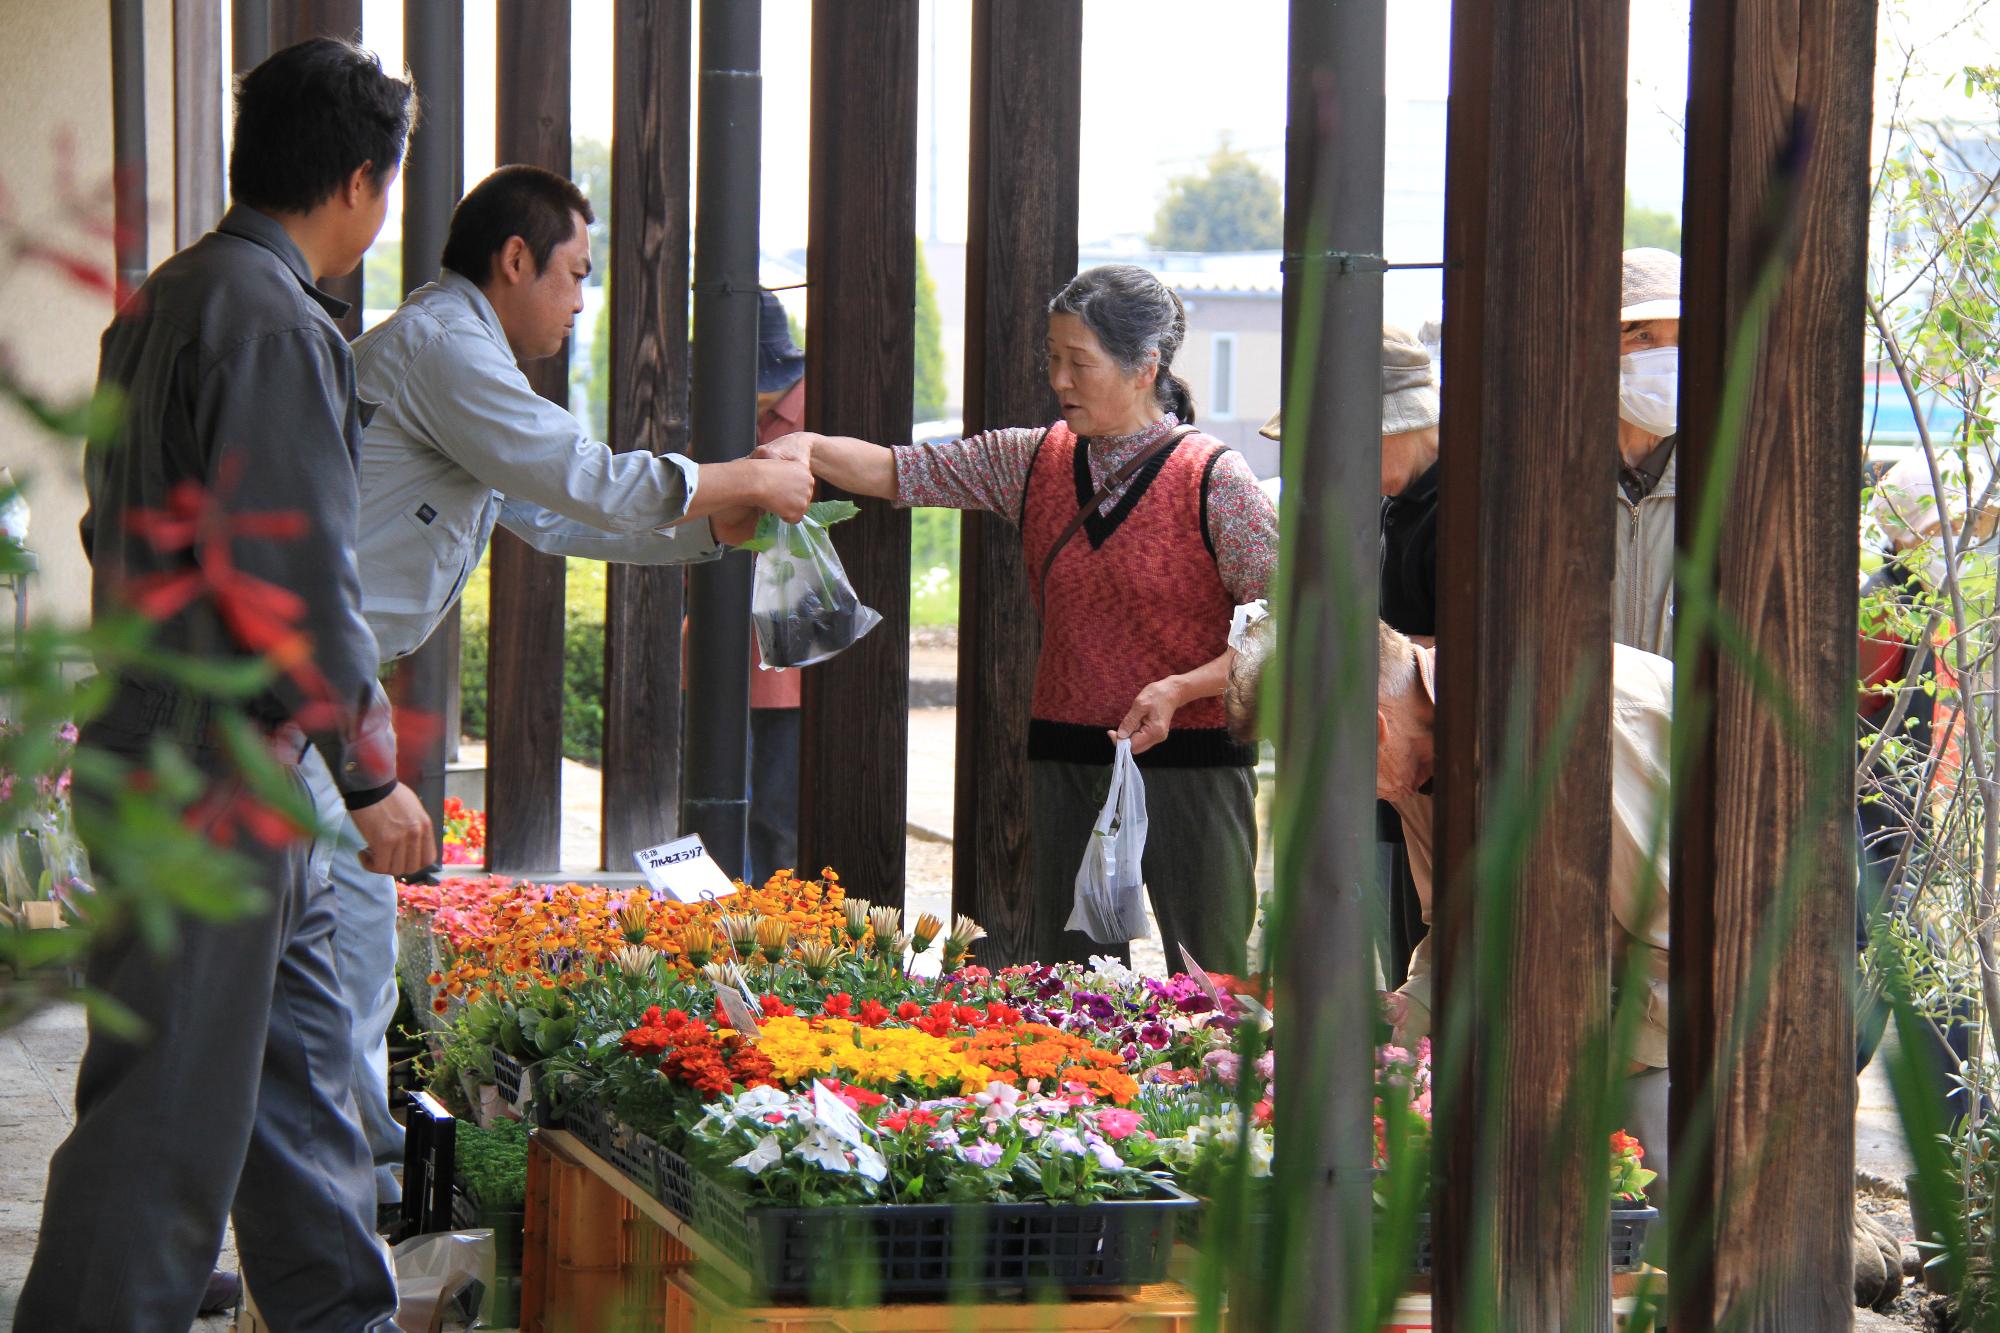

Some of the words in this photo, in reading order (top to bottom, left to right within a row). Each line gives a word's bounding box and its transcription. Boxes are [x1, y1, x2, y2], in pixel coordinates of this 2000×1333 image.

[649, 846, 703, 868] カルセオラリア
